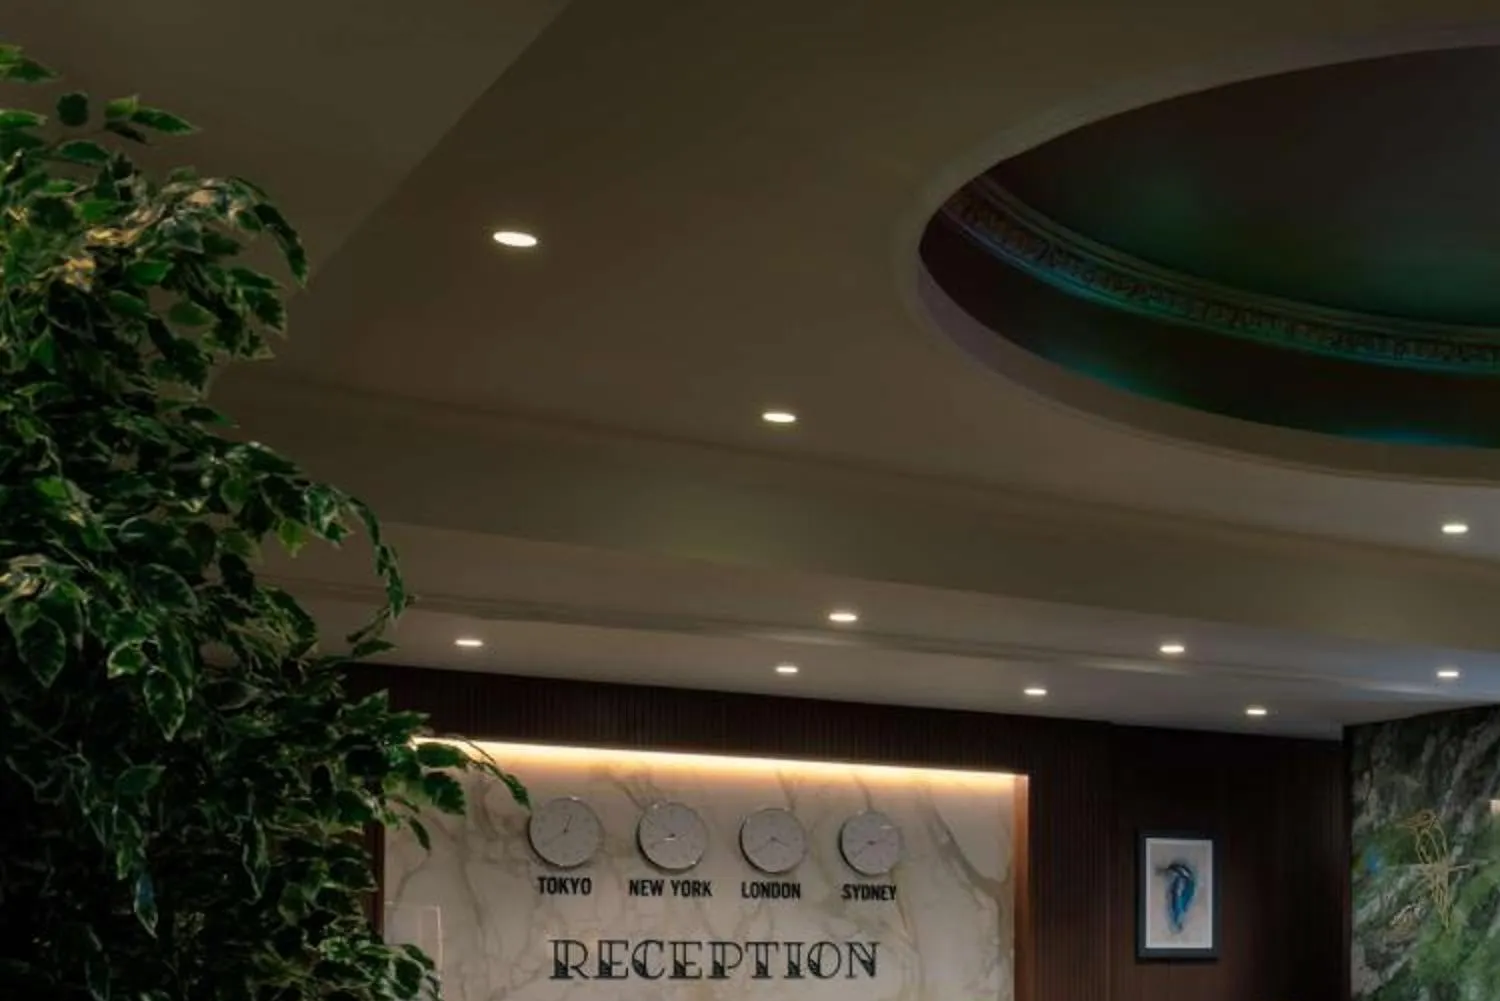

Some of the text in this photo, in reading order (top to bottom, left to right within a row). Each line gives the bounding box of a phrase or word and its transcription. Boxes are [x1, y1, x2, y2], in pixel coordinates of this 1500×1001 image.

[538, 877, 592, 895] TOKYO
[629, 880, 712, 897] NEW YORK
[741, 882, 801, 899] LONDON
[841, 884, 897, 900] SYDNEY
[550, 940, 880, 980] RECEPTION
